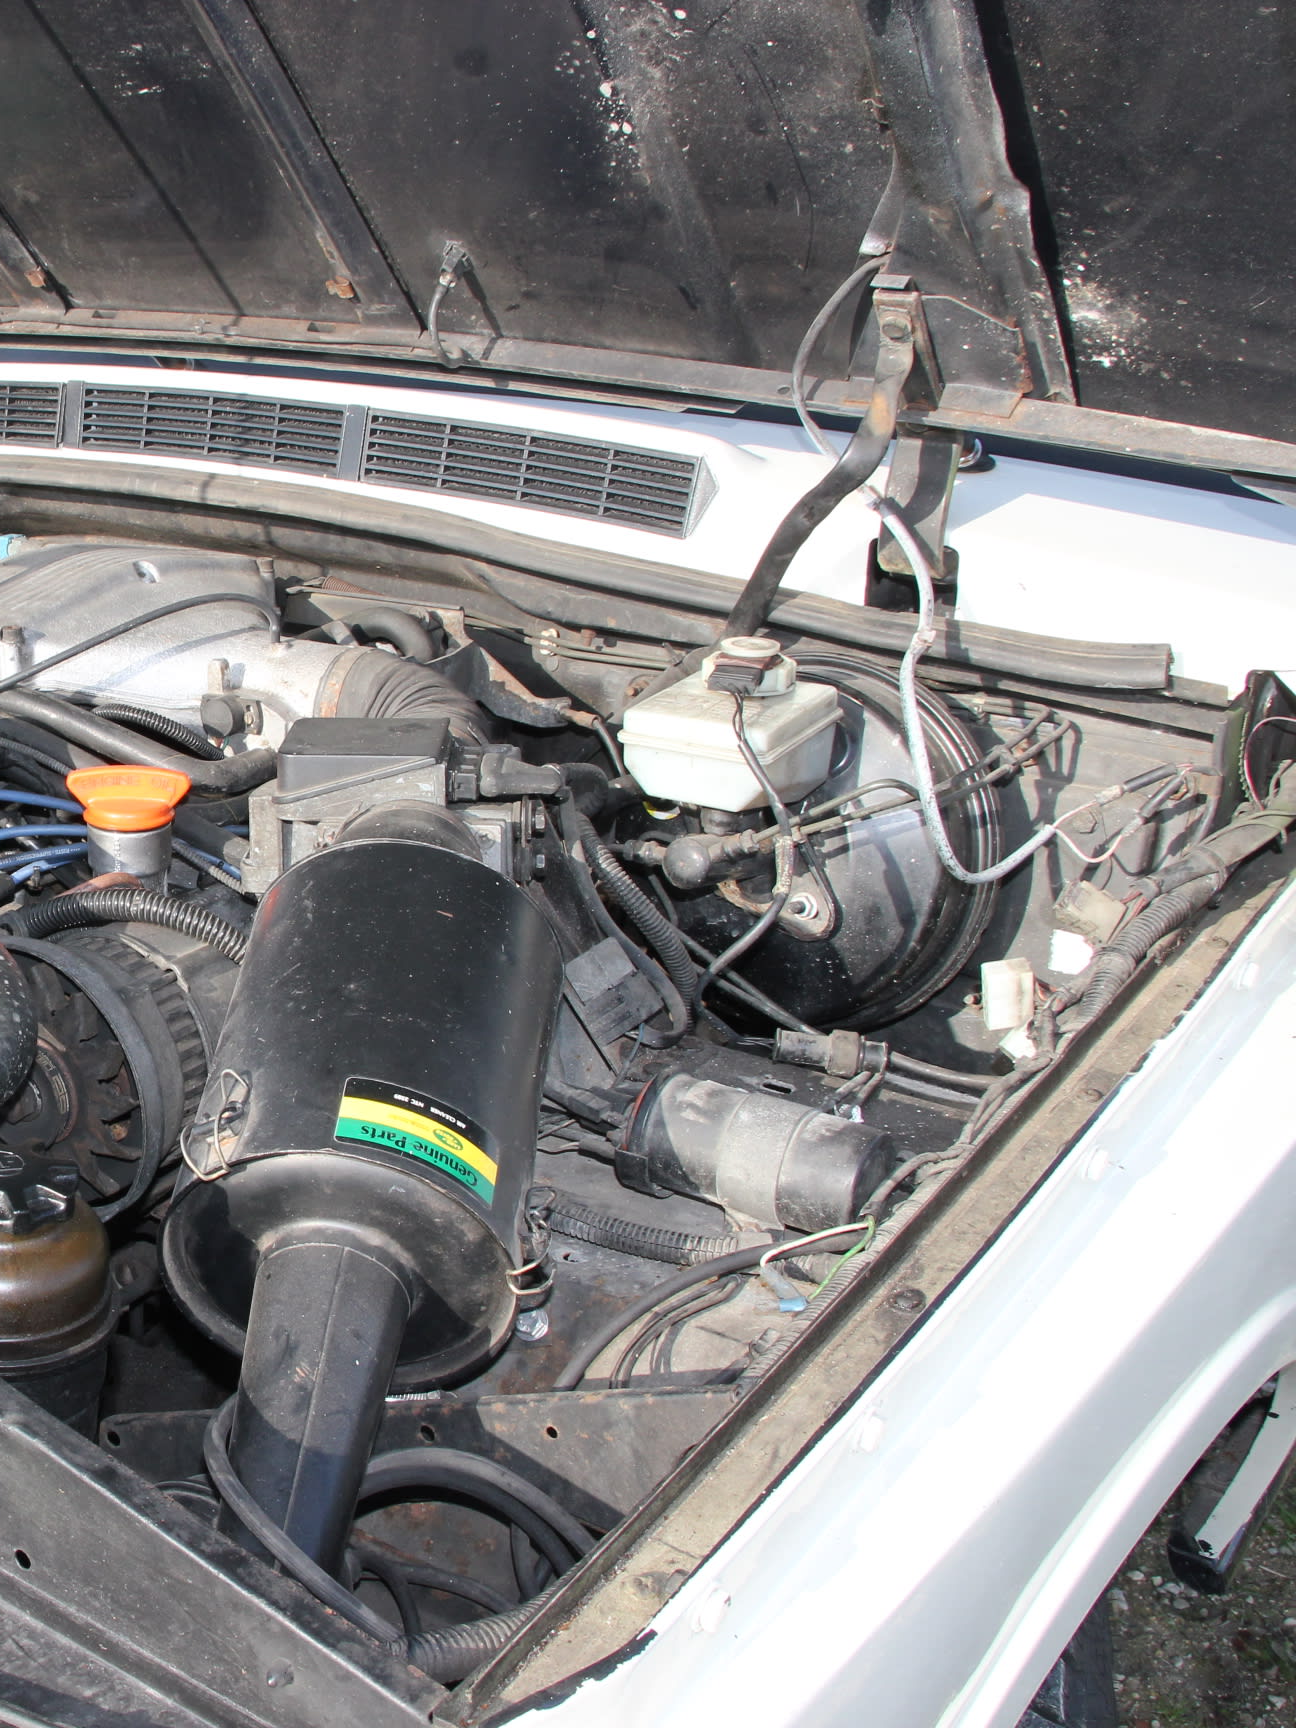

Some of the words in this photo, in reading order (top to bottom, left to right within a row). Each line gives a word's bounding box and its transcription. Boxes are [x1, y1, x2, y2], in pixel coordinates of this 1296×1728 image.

[410, 1098, 425, 1108] NTC
[430, 1106, 456, 1123] CLEANER
[361, 1124, 407, 1147] Parts
[413, 1140, 478, 1187] Genuine
